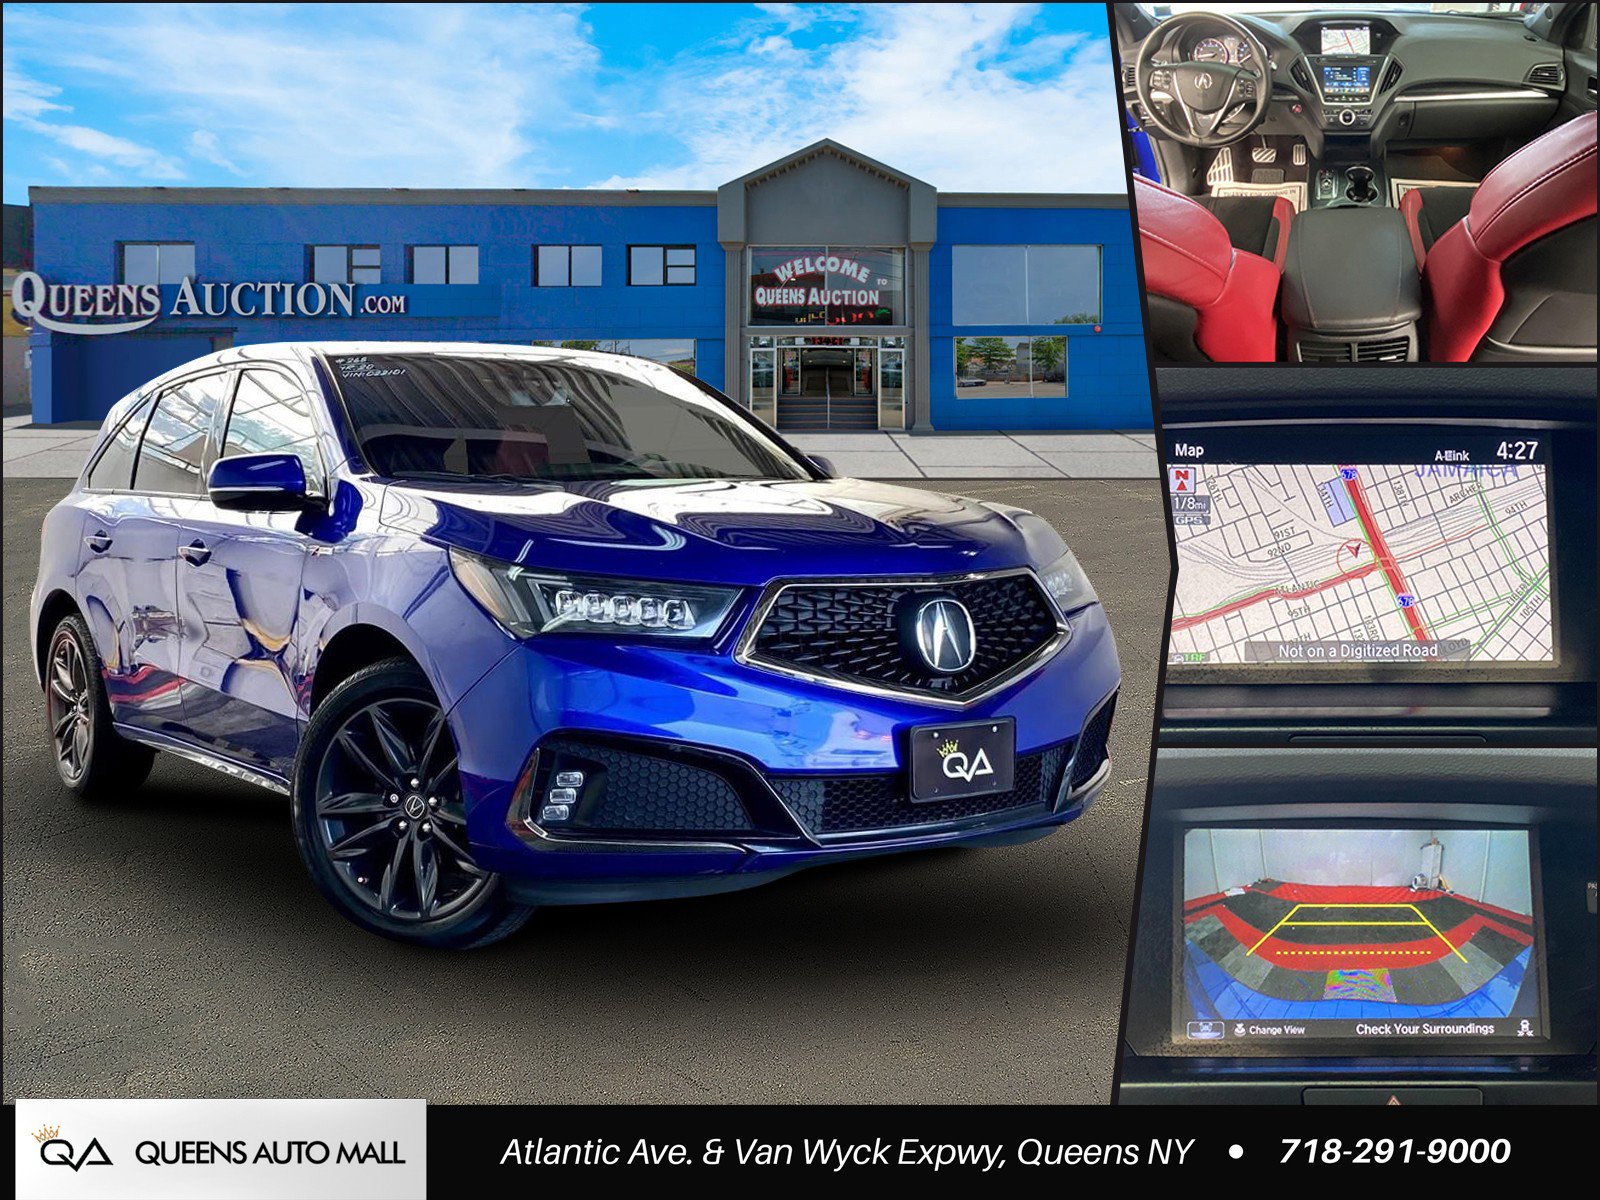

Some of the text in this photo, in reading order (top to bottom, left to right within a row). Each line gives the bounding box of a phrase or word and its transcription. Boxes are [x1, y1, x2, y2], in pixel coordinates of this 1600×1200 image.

[774, 255, 872, 285] WELCOME
[12, 271, 161, 335] QUEENS
[755, 286, 880, 307] QUEENS AUCTION
[1175, 443, 1204, 459] Map
[1496, 441, 1539, 460] 4:27
[1449, 483, 1485, 504] ARCHER
[1175, 516, 1203, 525] GPS
[1274, 526, 1296, 539] 91ST
[1267, 542, 1292, 557] 92ND
[1279, 643, 1438, 659] Not on a Digitized Road
[1249, 1024, 1305, 1035] Change View
[1356, 1022, 1495, 1037] Check Your Surroundings
